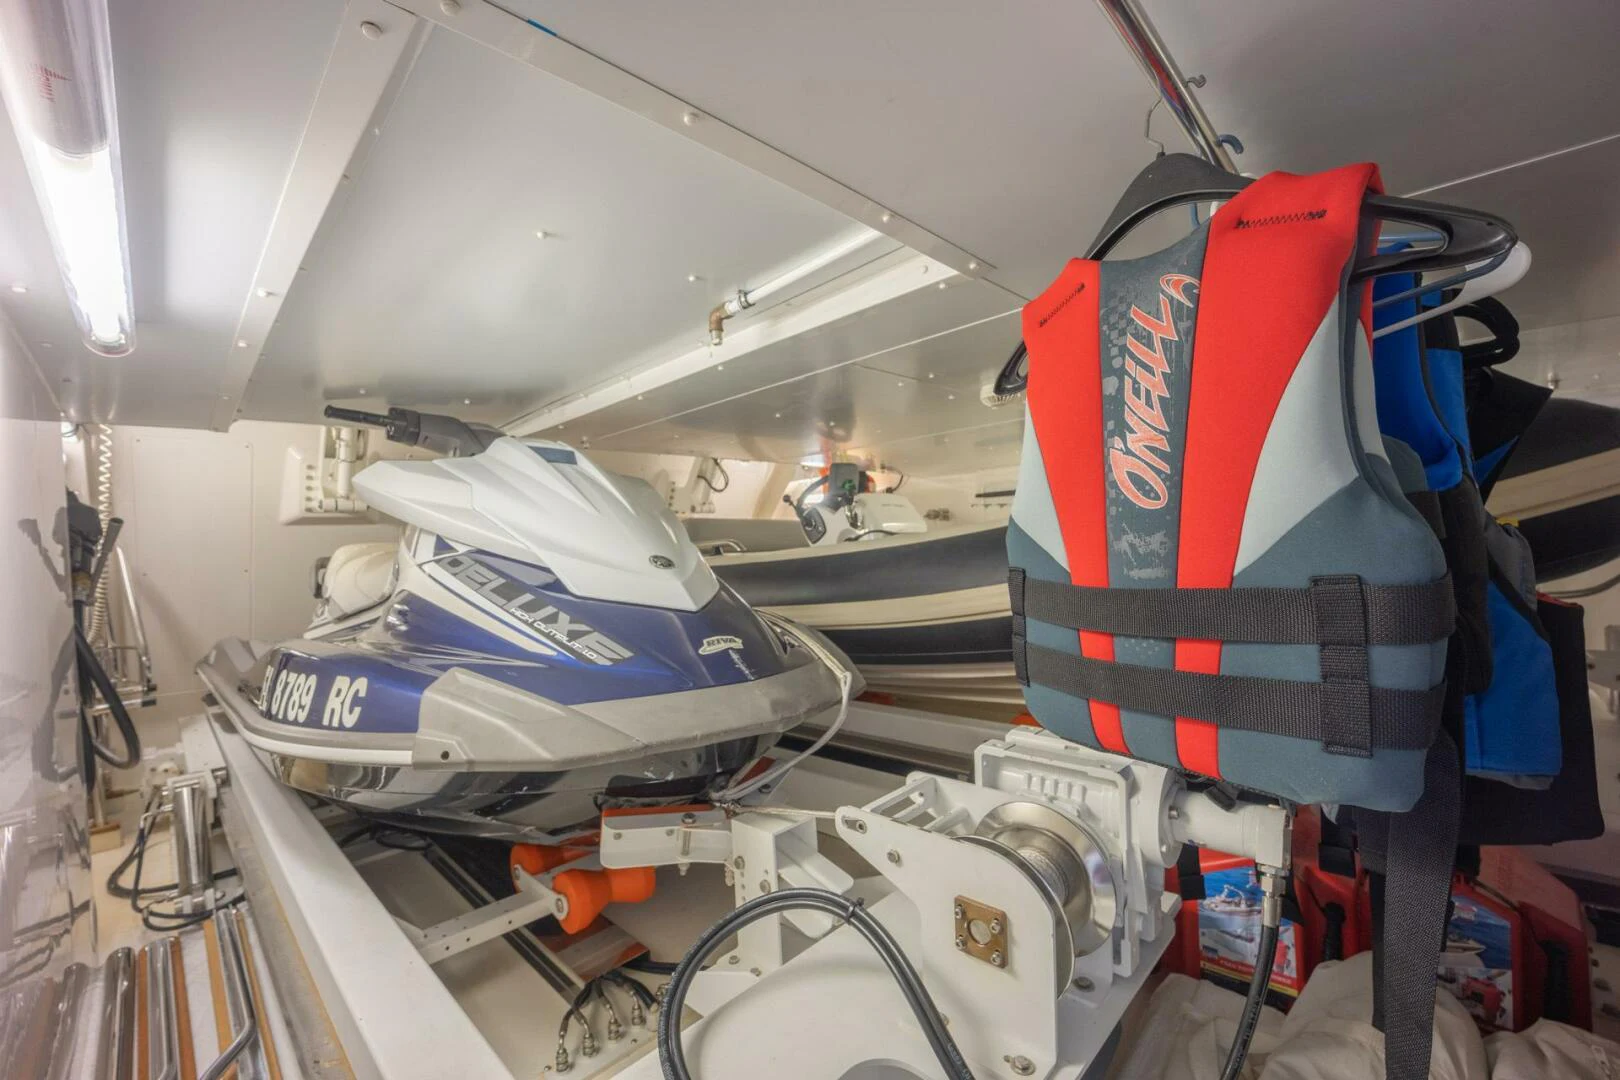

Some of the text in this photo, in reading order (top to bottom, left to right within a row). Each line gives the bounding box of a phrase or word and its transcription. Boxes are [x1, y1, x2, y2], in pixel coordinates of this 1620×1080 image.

[437, 555, 635, 665] DELUXE
[533, 621, 583, 650] OUTPUT
[270, 668, 318, 724] 8789
[322, 675, 369, 728] RC
